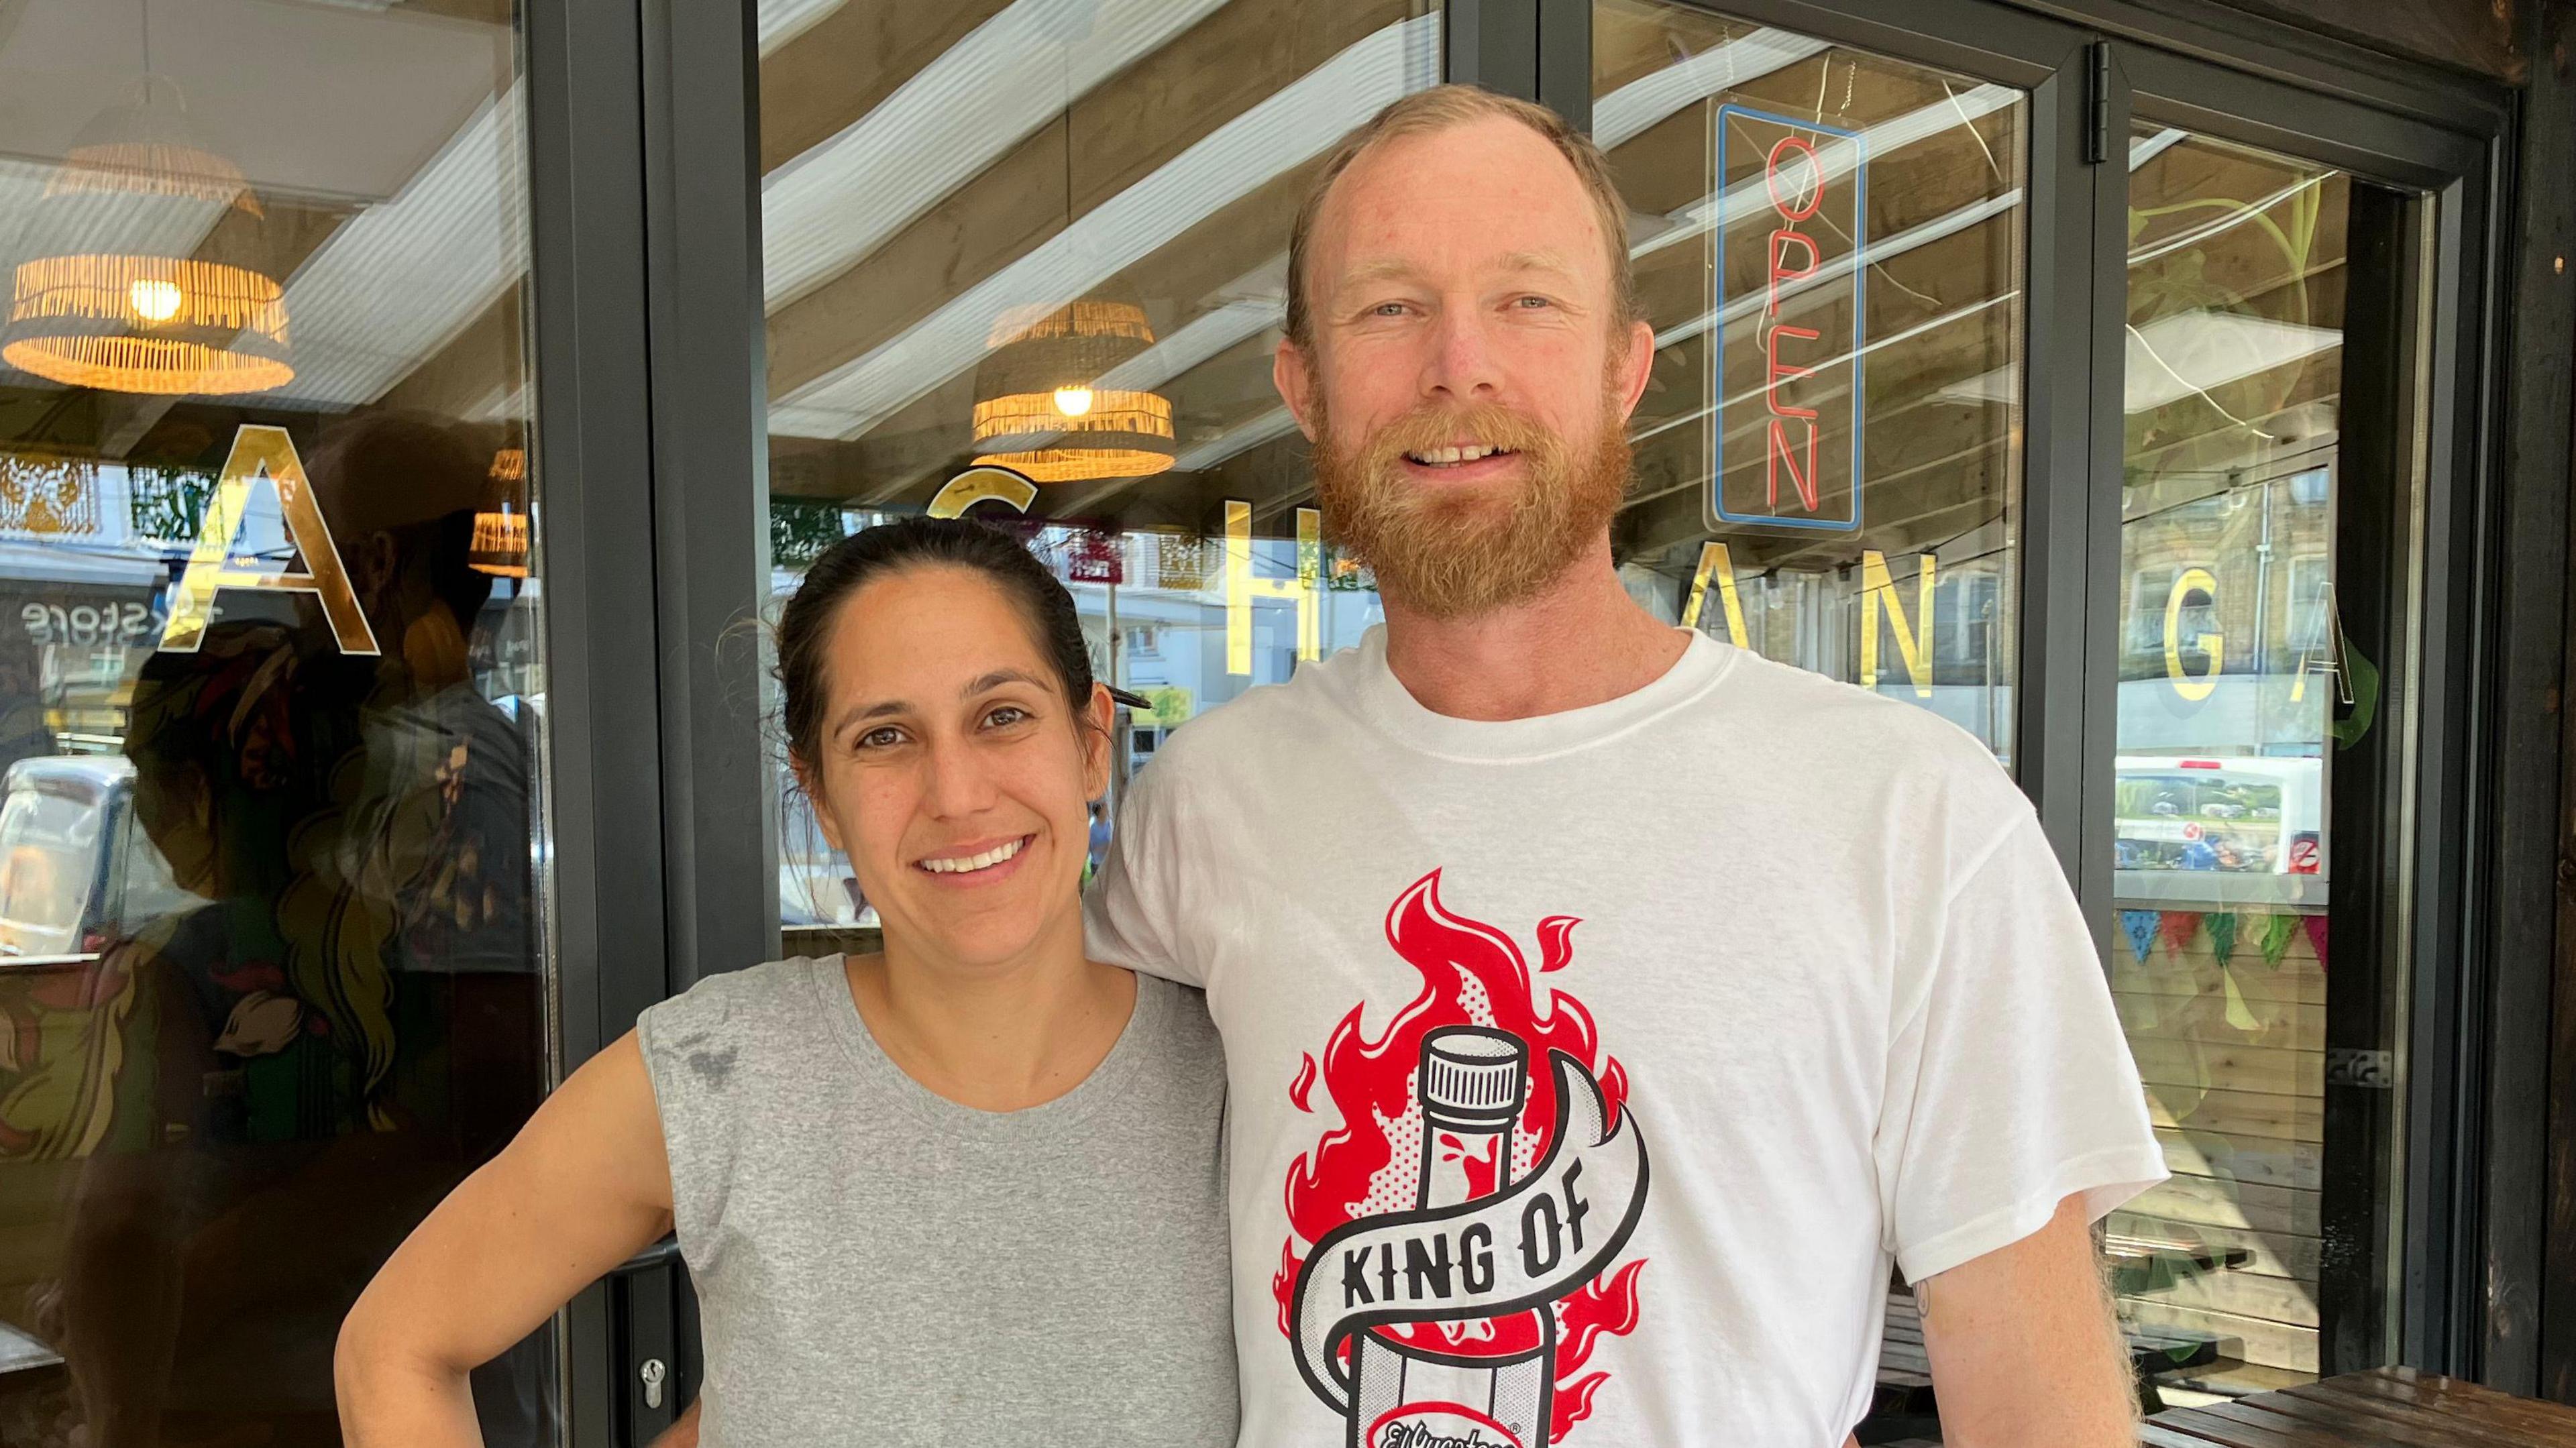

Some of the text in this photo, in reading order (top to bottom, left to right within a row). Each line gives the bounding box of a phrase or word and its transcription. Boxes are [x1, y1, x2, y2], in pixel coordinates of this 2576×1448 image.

[1767, 137, 1825, 512] OPEN
[1342, 1156, 1590, 1309] KING OF
